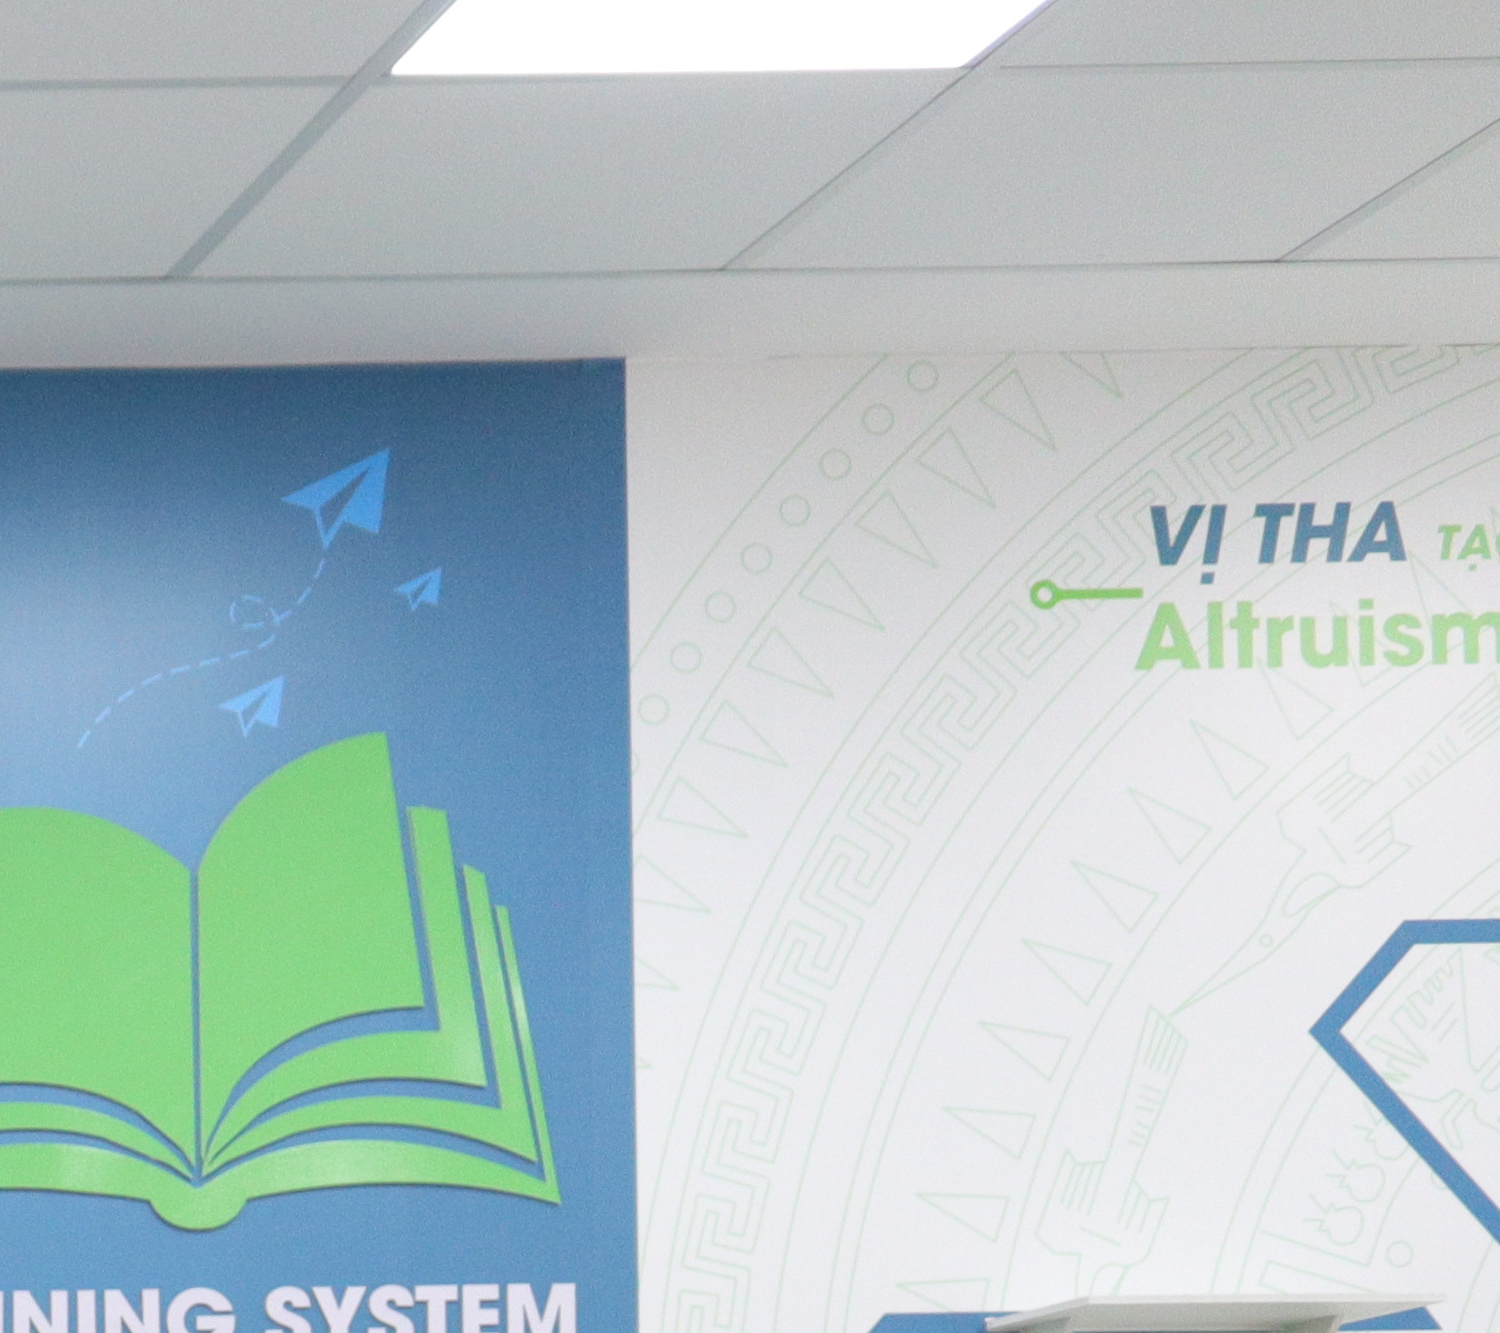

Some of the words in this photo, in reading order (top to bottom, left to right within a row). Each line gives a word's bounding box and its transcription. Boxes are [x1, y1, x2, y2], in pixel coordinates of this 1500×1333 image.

[1150, 503, 1227, 585] VỊ
[1254, 501, 1407, 564] THA
[1437, 523, 1500, 572] TẠ
[1134, 598, 1500, 671] Altruism
